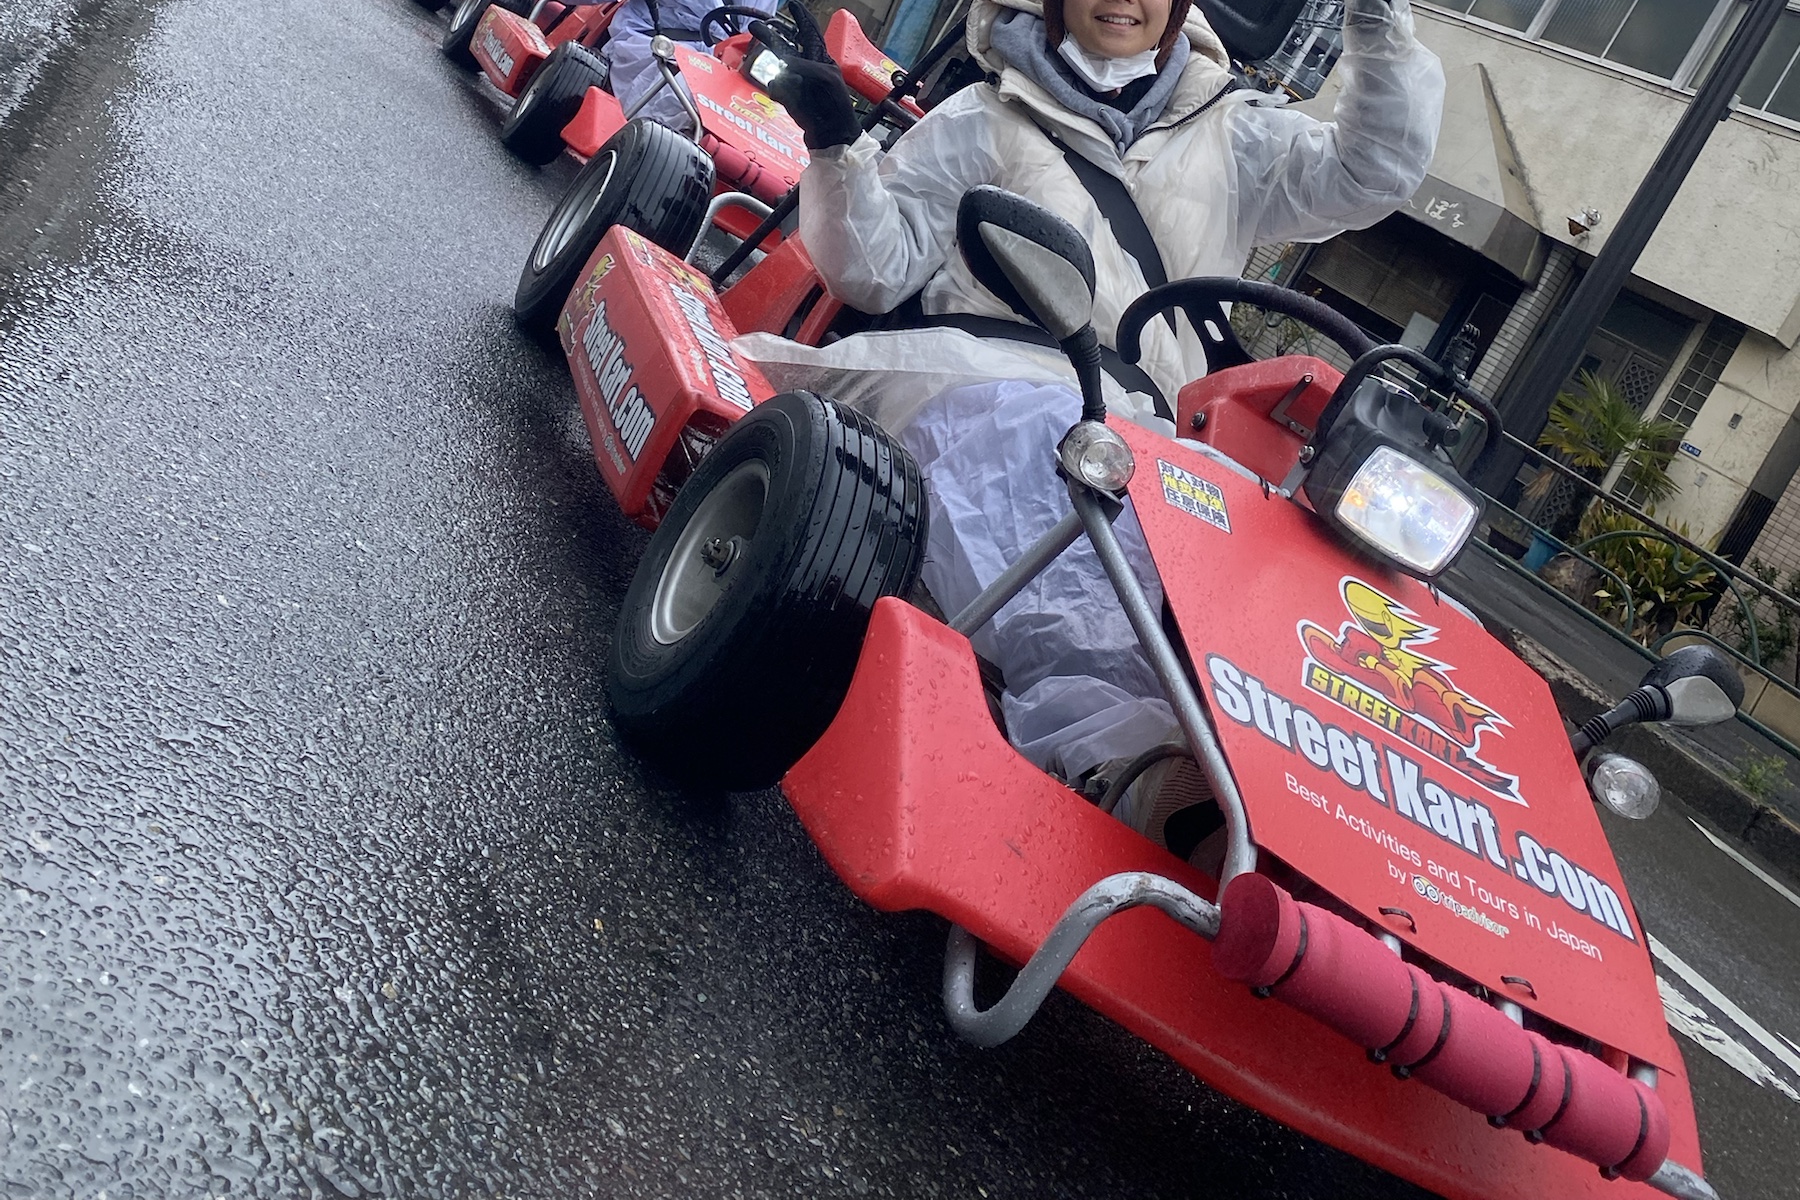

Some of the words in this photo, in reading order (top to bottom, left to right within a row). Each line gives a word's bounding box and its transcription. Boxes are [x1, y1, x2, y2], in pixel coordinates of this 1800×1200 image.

[696, 91, 755, 137] Street
[1207, 655, 1388, 805] Street
[1284, 771, 1331, 815] Best
[1335, 805, 1422, 867] Activities
[1427, 860, 1462, 890] and
[1463, 875, 1519, 920] Tours
[1523, 907, 1542, 932] in
[1546, 920, 1603, 962] Japan
[1387, 859, 1408, 886] by
[1440, 887, 1510, 939] tripadvisor
